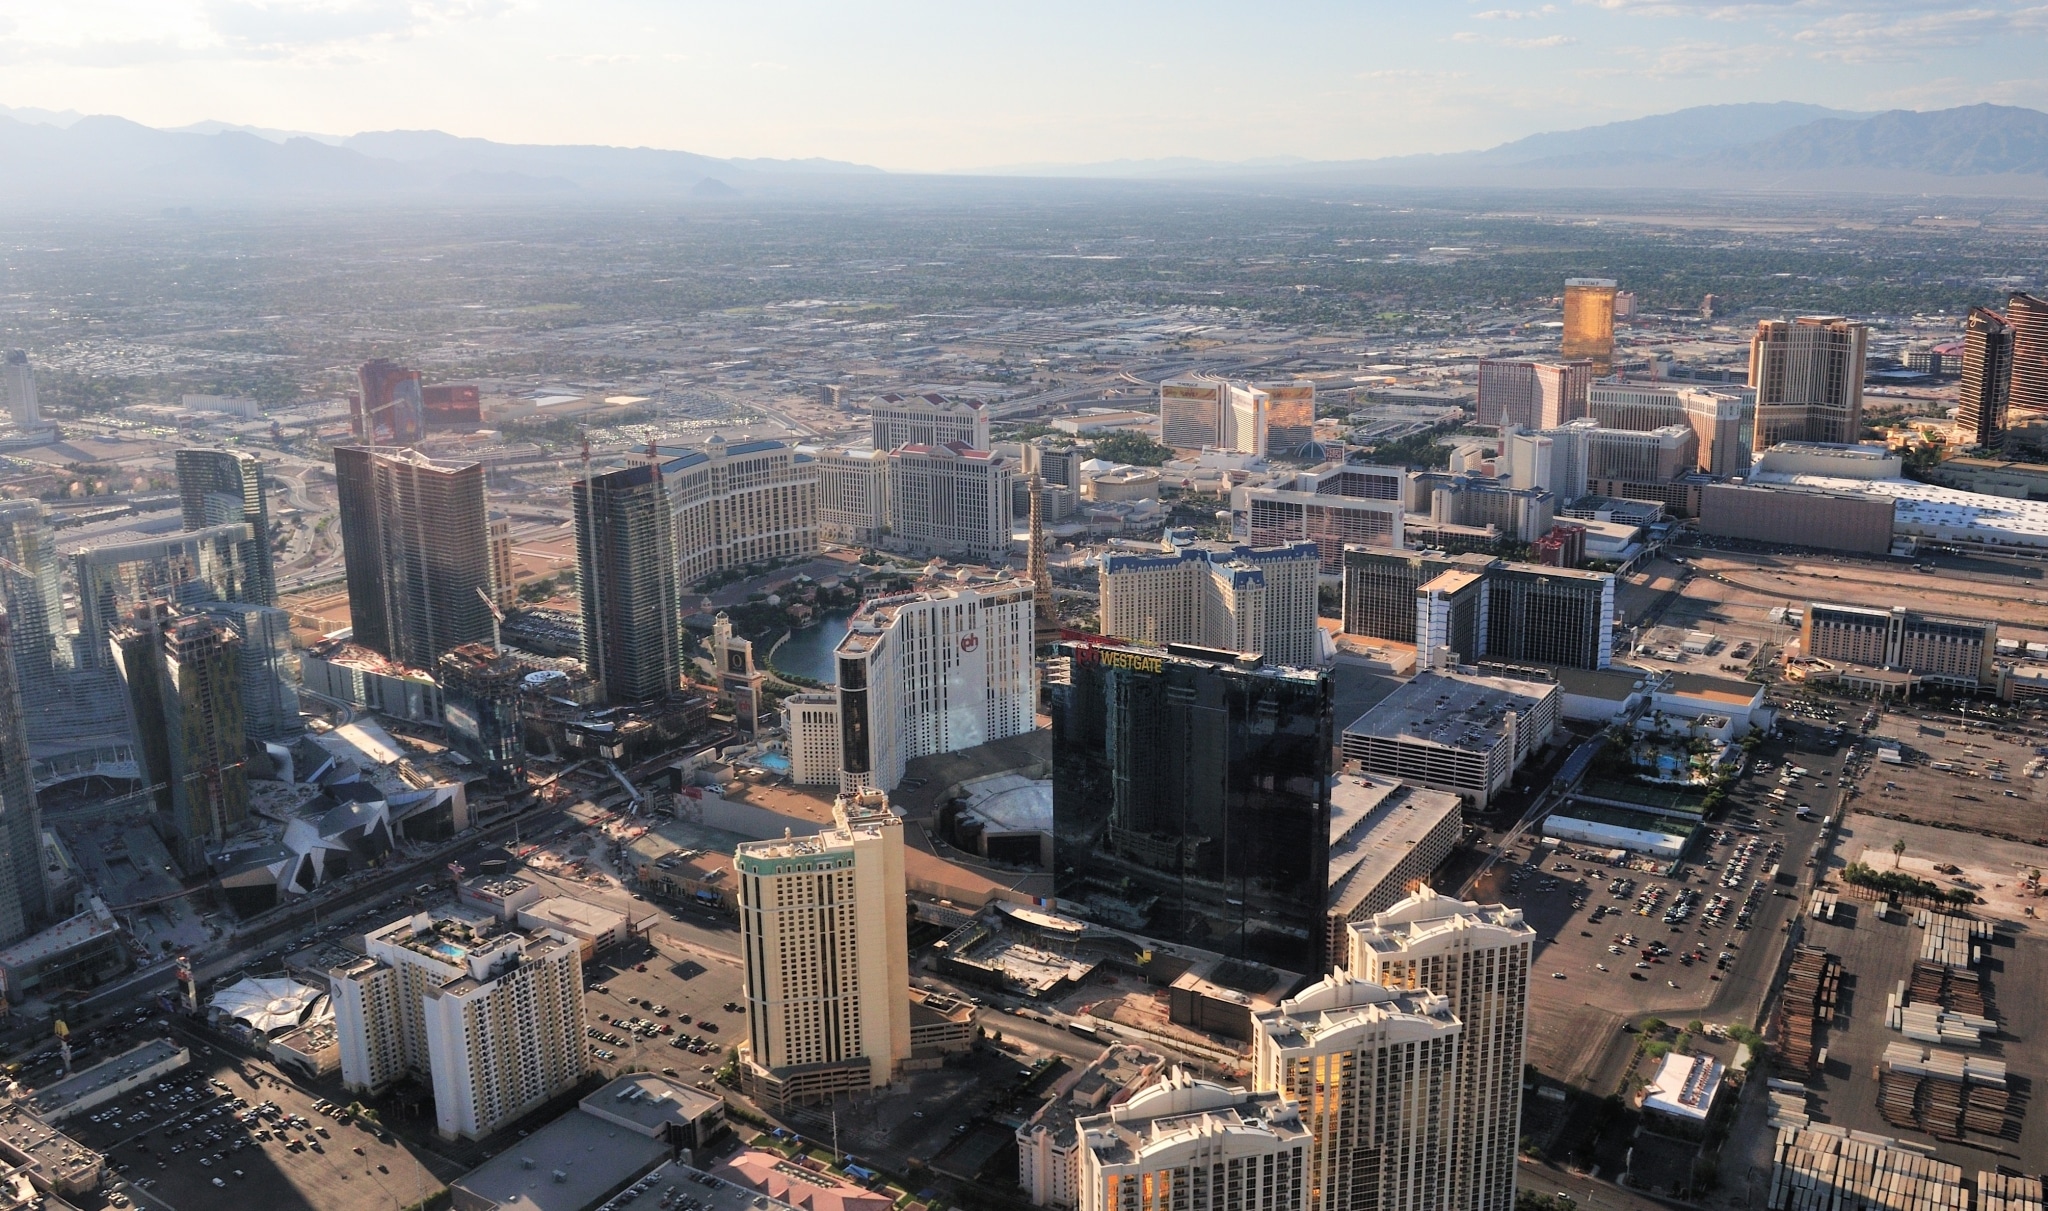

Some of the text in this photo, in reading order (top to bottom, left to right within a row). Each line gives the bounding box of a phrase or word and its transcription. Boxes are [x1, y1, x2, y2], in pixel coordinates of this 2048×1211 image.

[962, 633, 979, 651] ph
[1101, 650, 1163, 673] WESTGATE
[496, 956, 546, 987] POLO TOWERS
